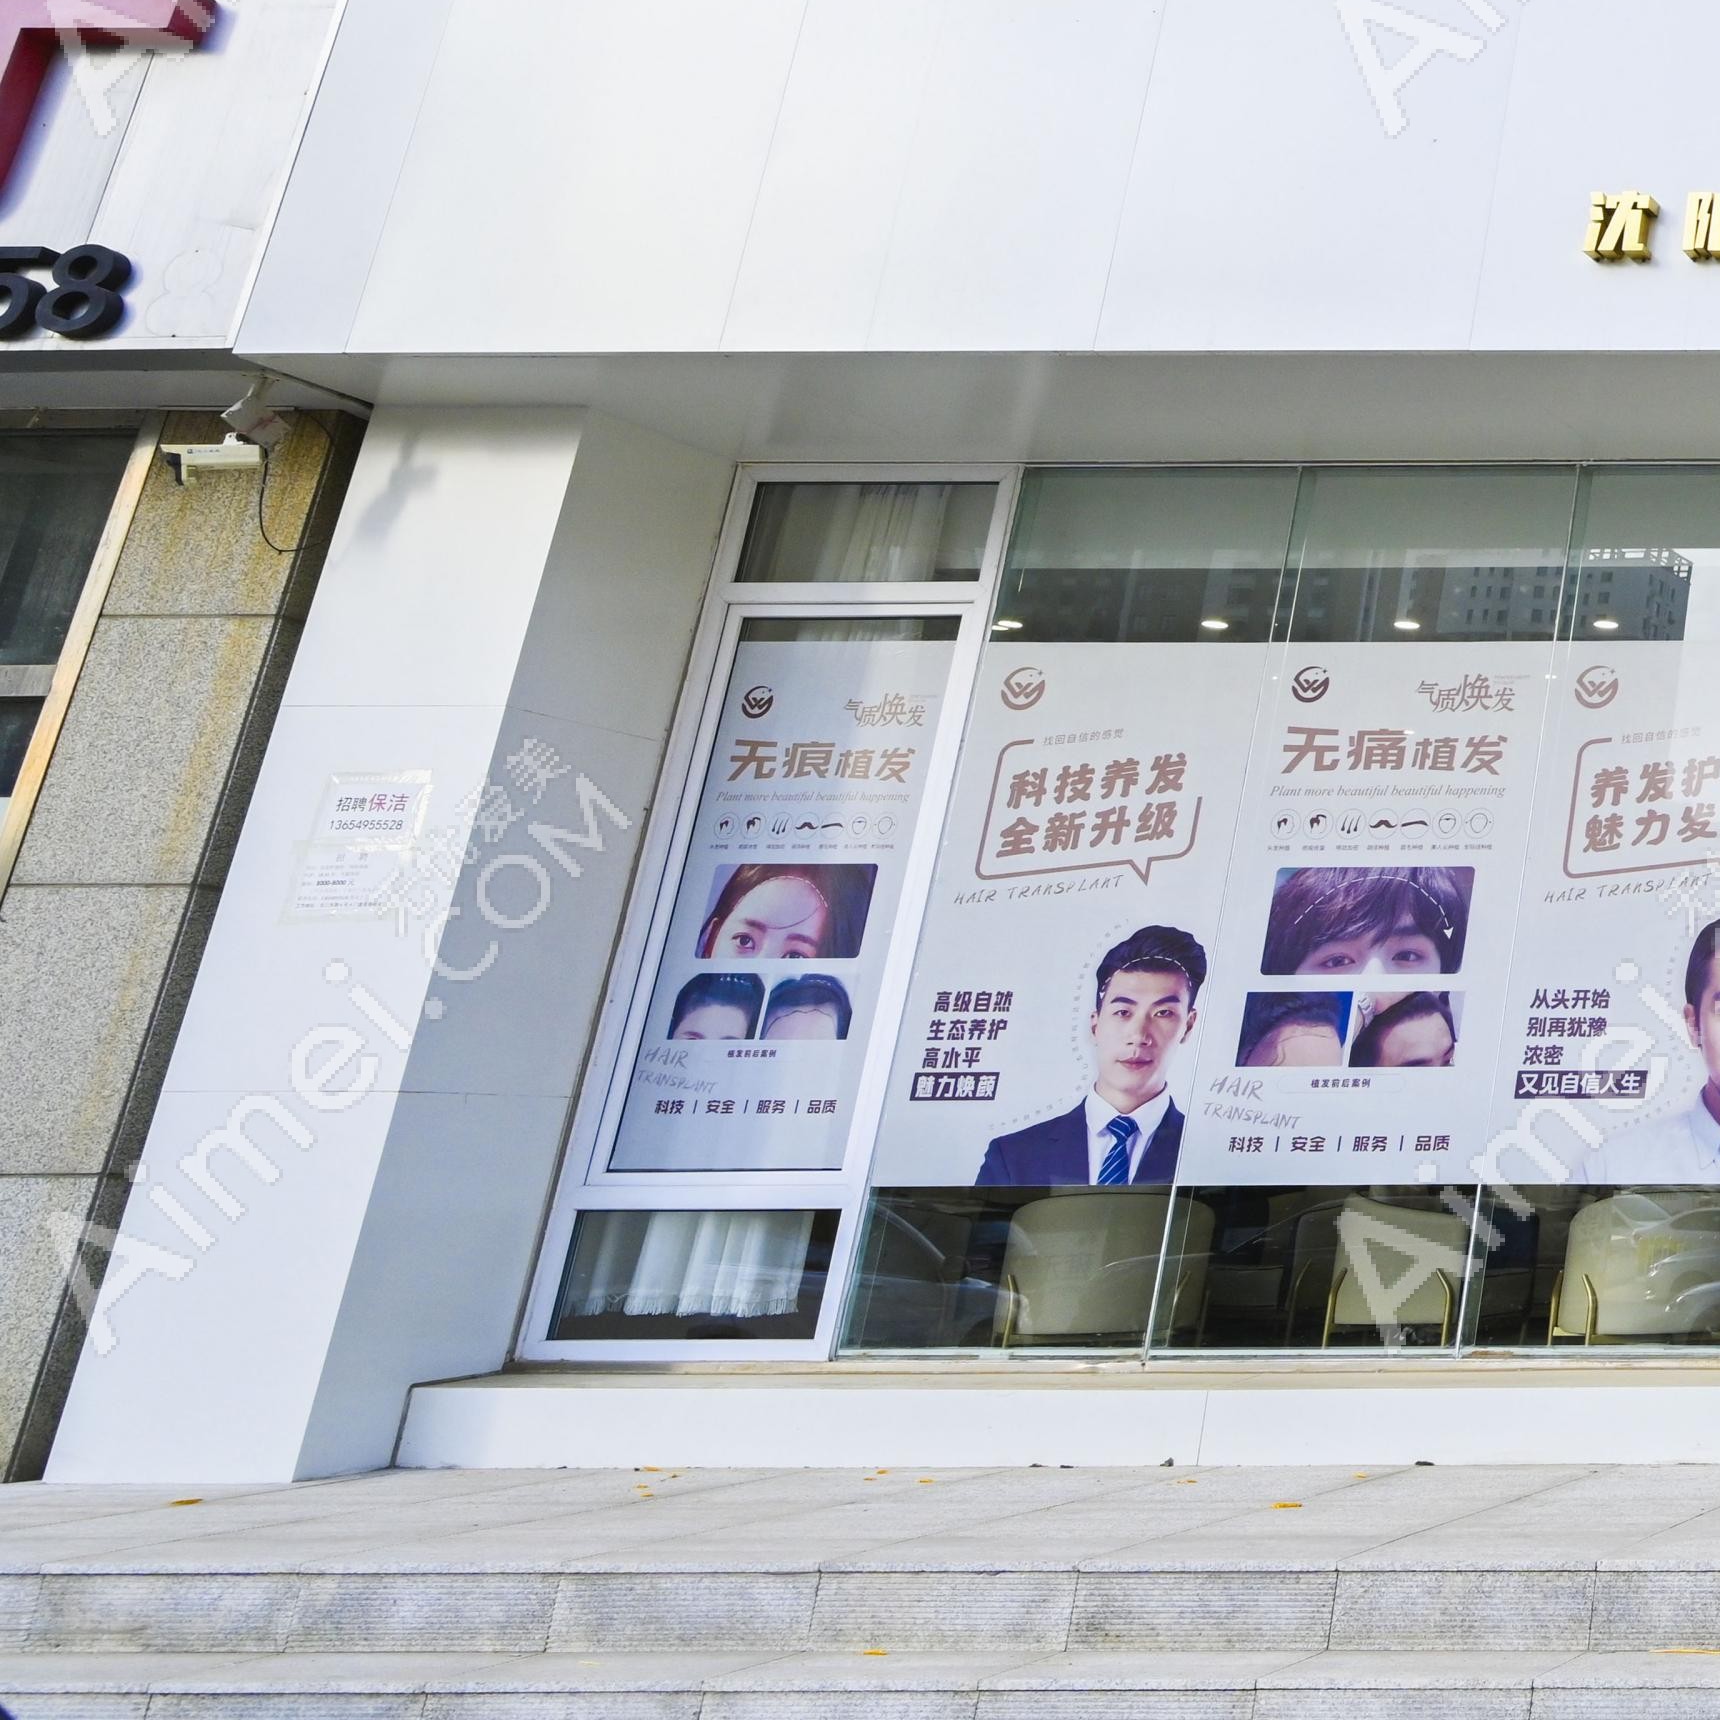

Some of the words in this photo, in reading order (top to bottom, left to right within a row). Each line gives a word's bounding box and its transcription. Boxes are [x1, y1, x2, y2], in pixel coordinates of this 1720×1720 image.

[1415, 673, 1516, 713] 气质焕发
[843, 693, 926, 727] 气质焕发
[1042, 728, 1124, 746] 找回自信的感觉
[1280, 725, 1509, 776] 无痛植发
[727, 739, 918, 784] 无痕植发
[1006, 752, 1188, 810] 科技养发
[336, 793, 410, 812] 招聘保洁
[1270, 785, 1302, 796] Plant
[1305, 787, 1334, 796] more
[1337, 785, 1388, 799] beautiful
[1391, 785, 1442, 799] beautiful
[1445, 785, 1507, 799] happening
[330, 820, 404, 830] 13654955528
[996, 800, 1179, 859] 全新升级
[933, 991, 1013, 1013] 高级自然
[1530, 989, 1611, 1010] 从头开始
[926, 1019, 1008, 1041] 生态养护
[1526, 1017, 1608, 1038] 别再犹豫
[922, 1048, 982, 1069] 高水平
[1523, 1045, 1564, 1066] 浓密
[914, 1074, 998, 1099] 魅力焕颜
[1310, 1078, 1372, 1089] 植发前后案例
[1518, 1072, 1642, 1097] 又见自信人生
[654, 1100, 685, 1114] 科技
[706, 1100, 736, 1114] 安全
[756, 1100, 786, 1114] 服务
[807, 1100, 838, 1114] 品质
[1228, 1135, 1264, 1153] 科技
[1290, 1135, 1326, 1153] 安全
[1352, 1135, 1388, 1153] 服务
[1415, 1135, 1451, 1152] 品质
